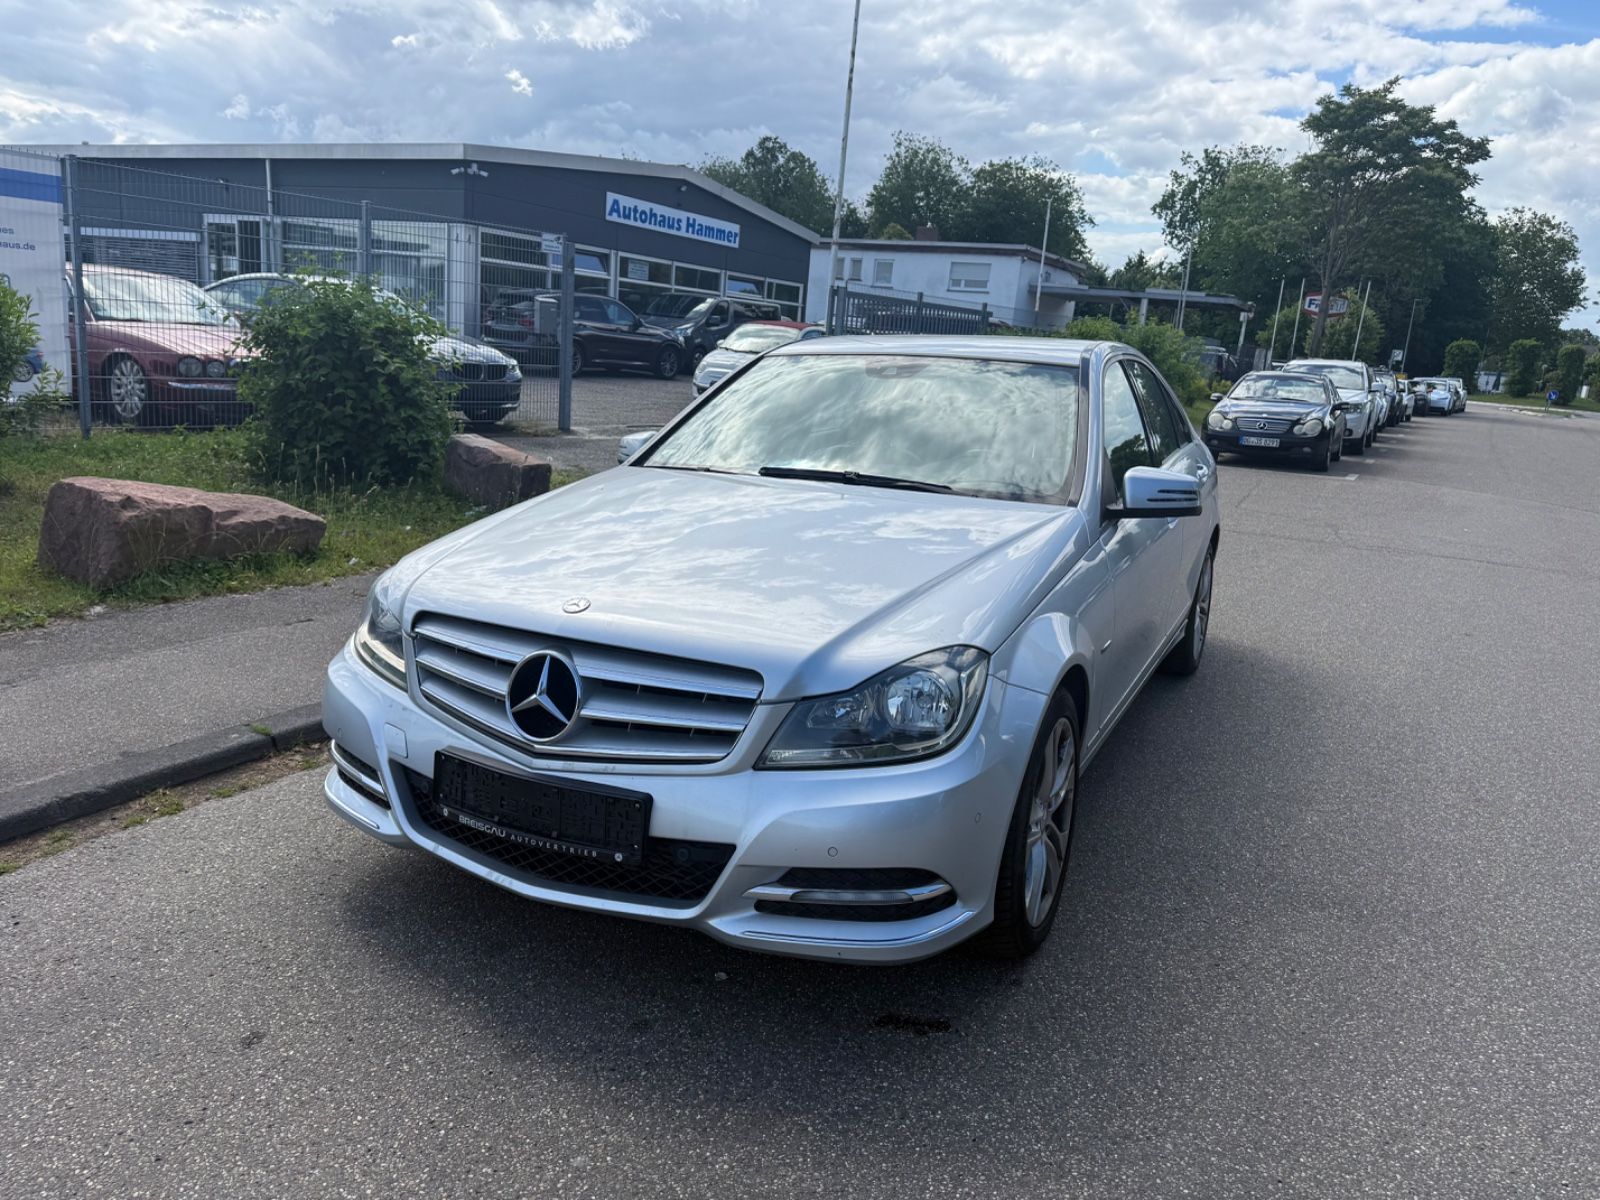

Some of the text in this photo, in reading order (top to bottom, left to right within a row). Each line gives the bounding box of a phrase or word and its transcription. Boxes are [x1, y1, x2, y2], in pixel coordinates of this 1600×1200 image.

[607, 198, 739, 244] Autohaus Hammer
[458, 814, 598, 859] BREISGAU AUTOVERTRIEB
